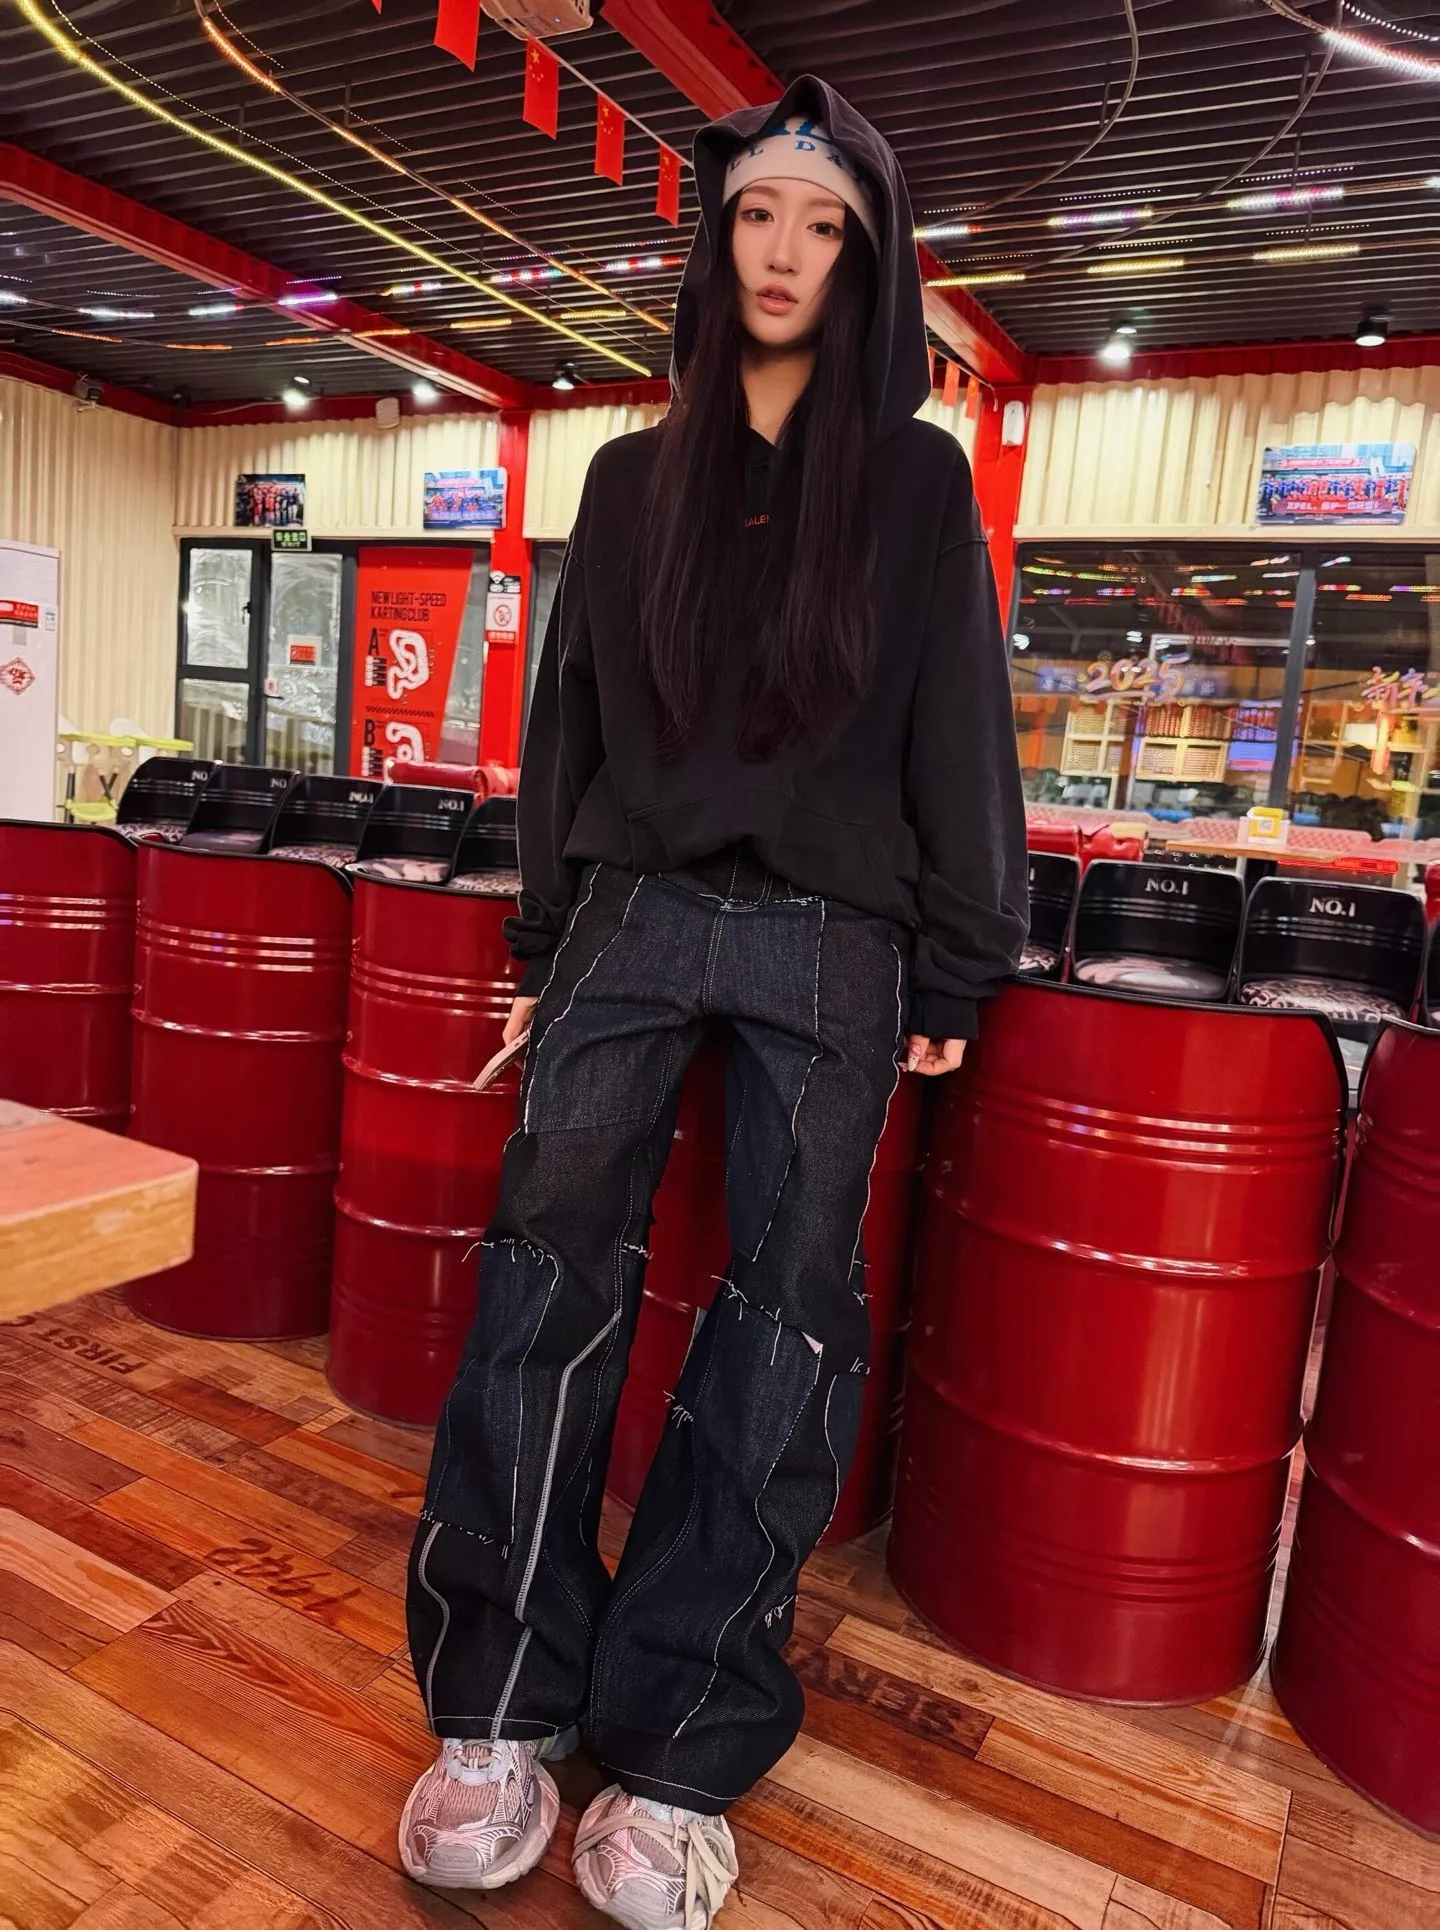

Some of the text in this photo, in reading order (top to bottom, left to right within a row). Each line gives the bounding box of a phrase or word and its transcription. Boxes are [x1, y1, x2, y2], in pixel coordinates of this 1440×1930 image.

[369, 628, 380, 656] A
[1084, 652, 1191, 700] 2025
[1360, 666, 1440, 707] 新年
[364, 718, 375, 746] B
[191, 770, 208, 781] NO
[270, 778, 287, 789] NO
[1145, 877, 1189, 896] NO.1
[1308, 897, 1356, 918] NO.1
[29, 1327, 148, 1375] FIRST
